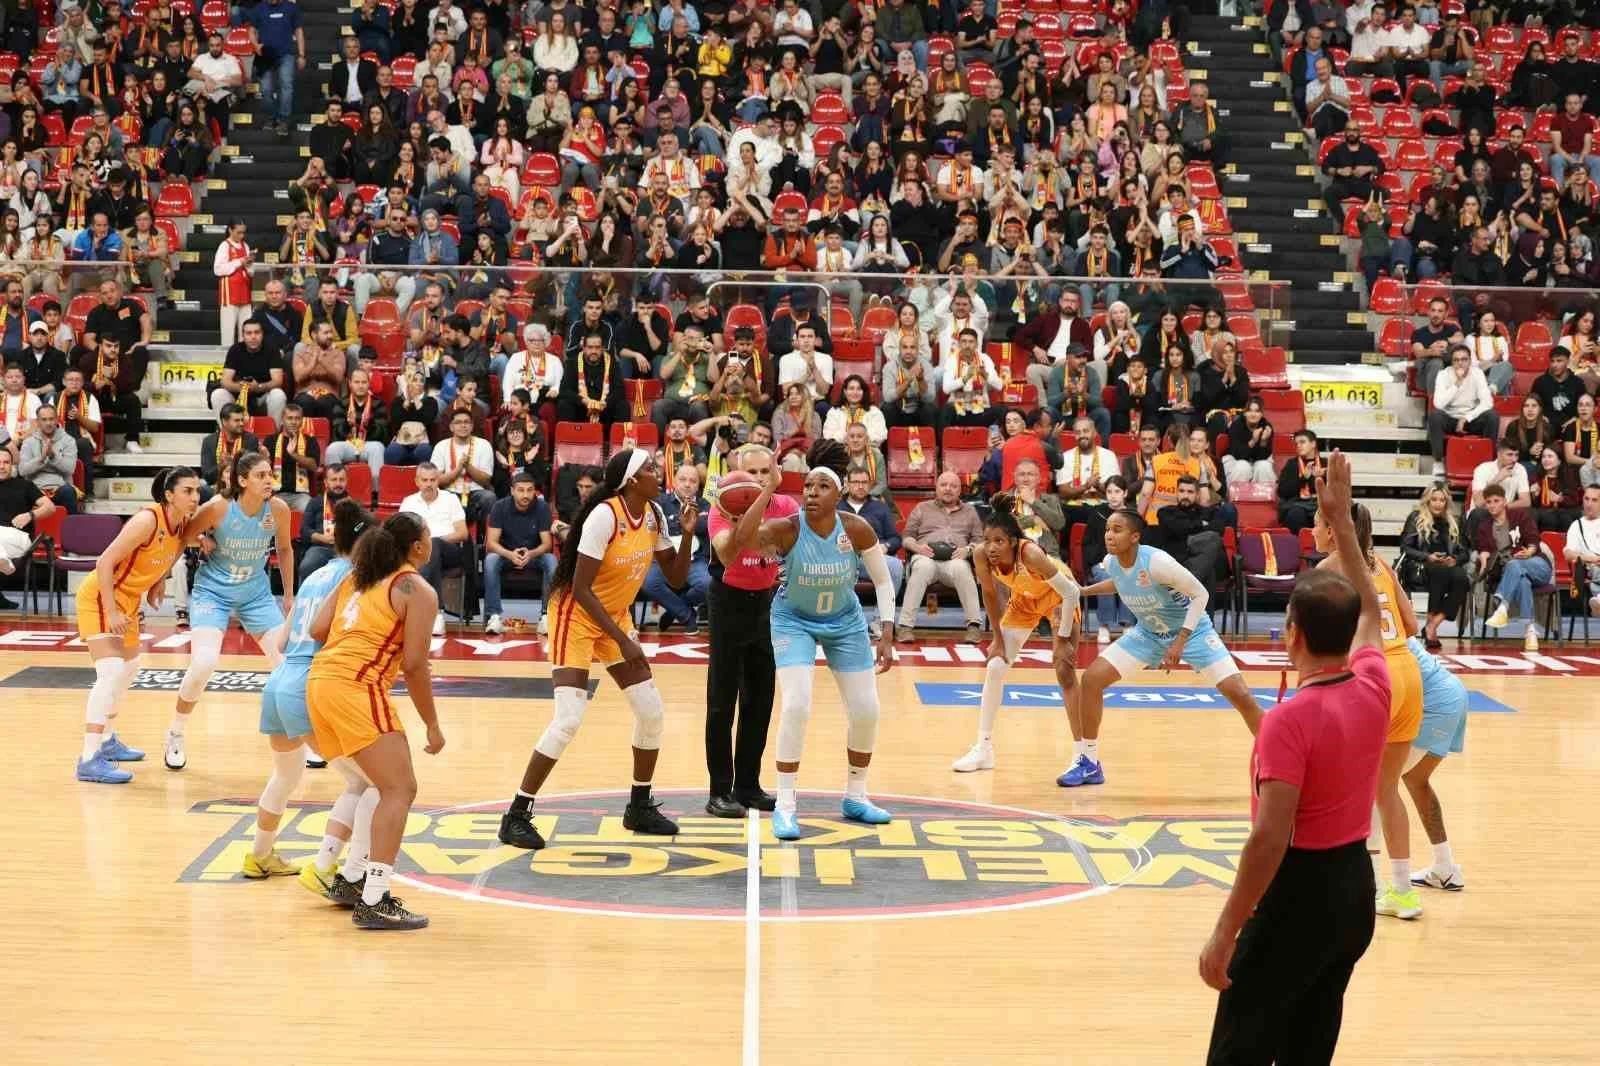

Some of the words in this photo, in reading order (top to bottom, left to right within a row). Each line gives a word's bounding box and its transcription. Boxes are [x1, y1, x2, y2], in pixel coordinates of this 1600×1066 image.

[1304, 388, 1335, 404] 014
[1347, 389, 1378, 406] 013
[801, 559, 850, 575] TURGUTLU
[816, 591, 834, 614] 0
